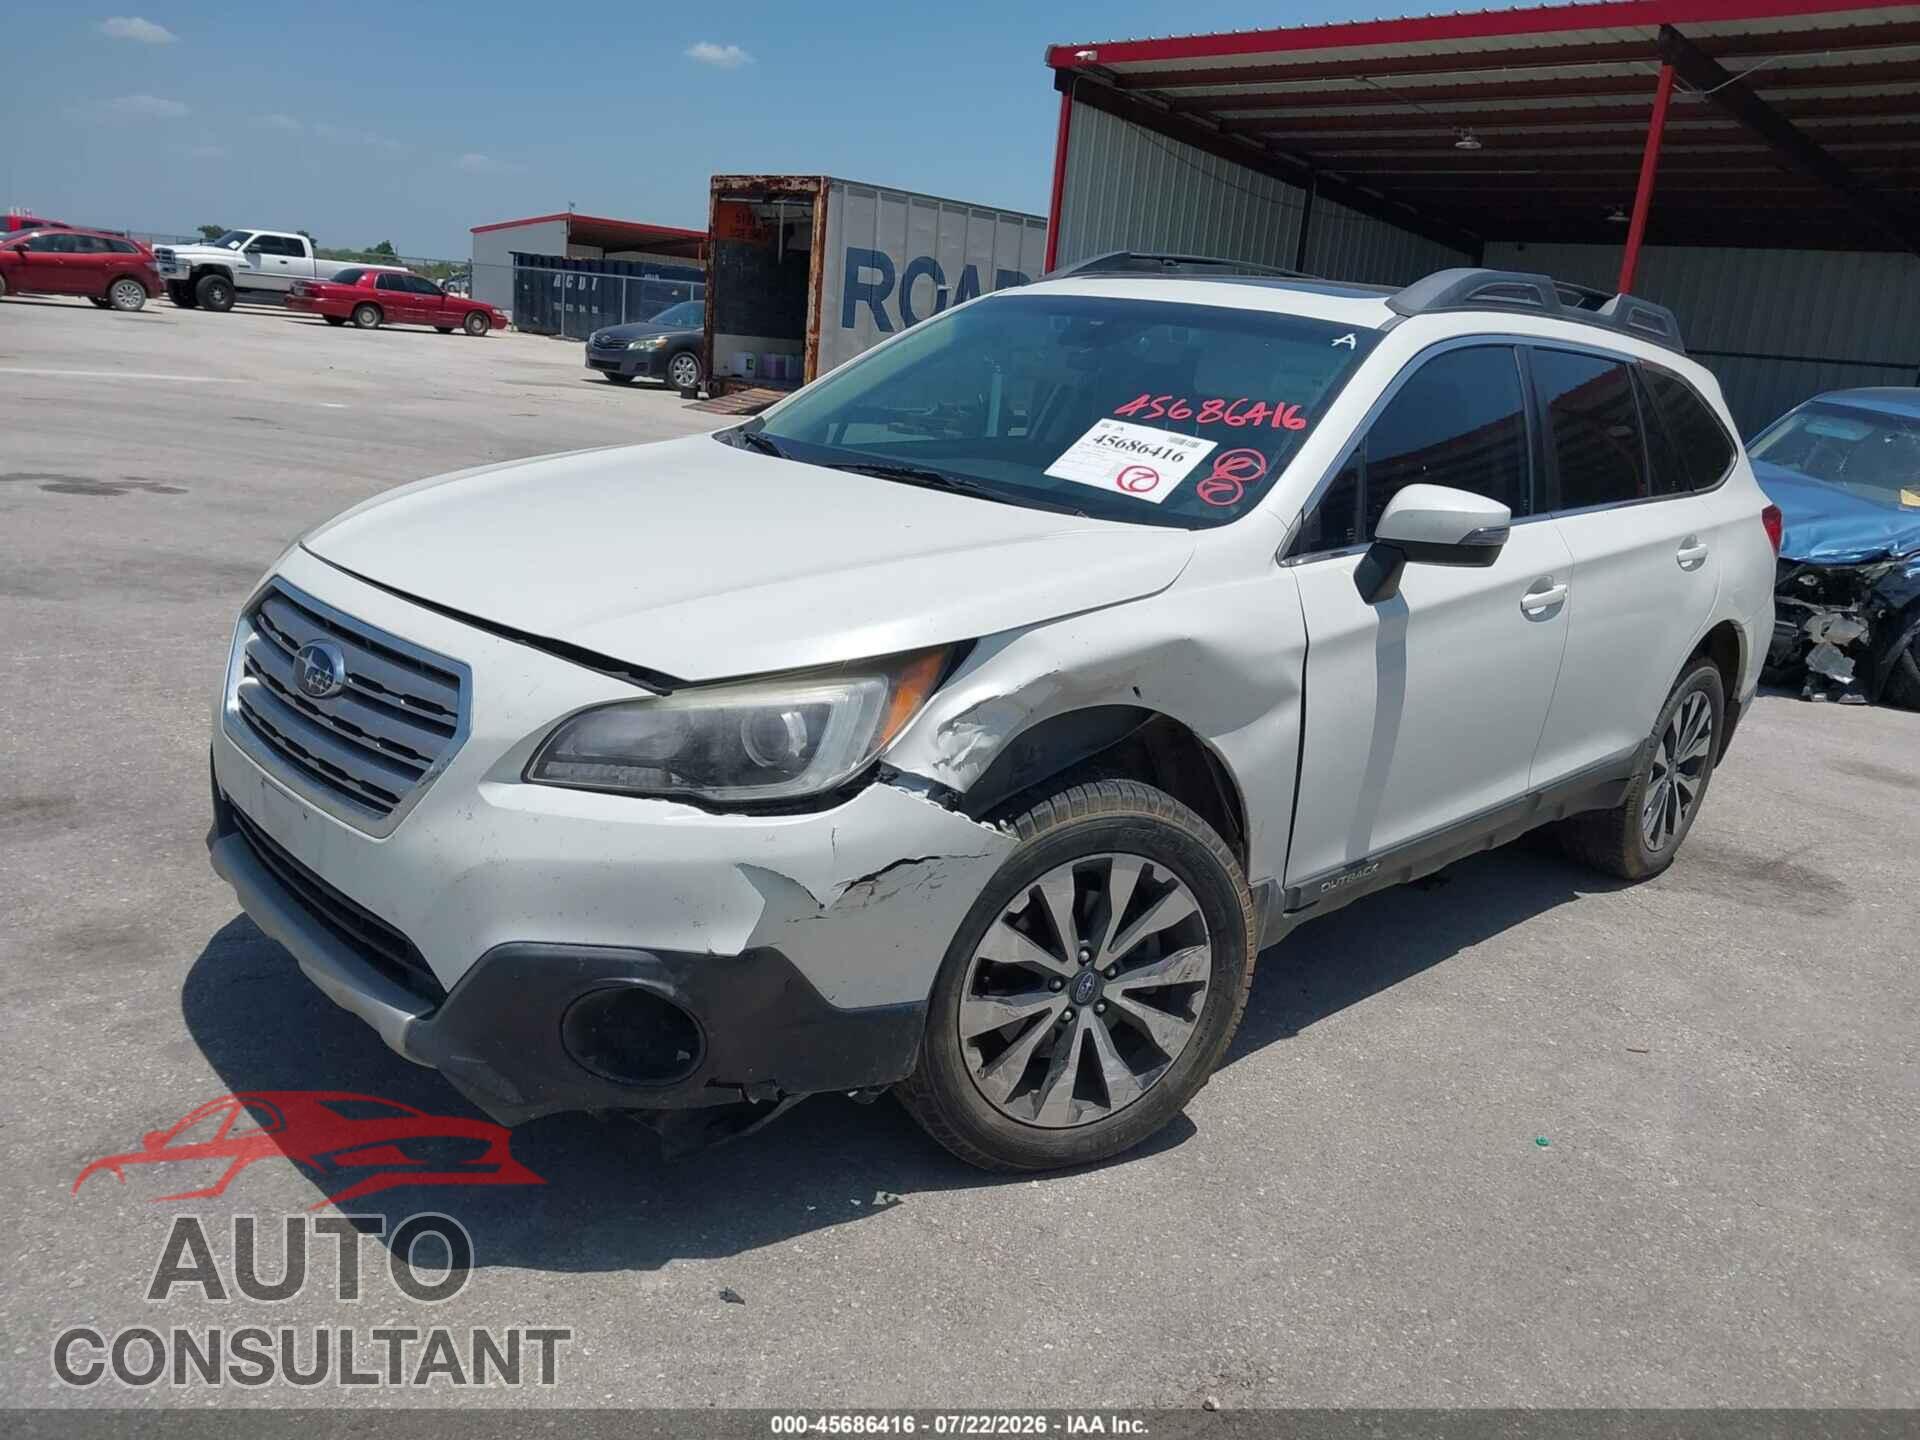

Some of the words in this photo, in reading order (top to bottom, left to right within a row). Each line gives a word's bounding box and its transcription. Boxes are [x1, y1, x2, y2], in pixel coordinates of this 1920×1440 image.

[1331, 332, 1357, 350] A
[1114, 394, 1307, 431] 45686416
[1093, 433, 1186, 463] 45686416
